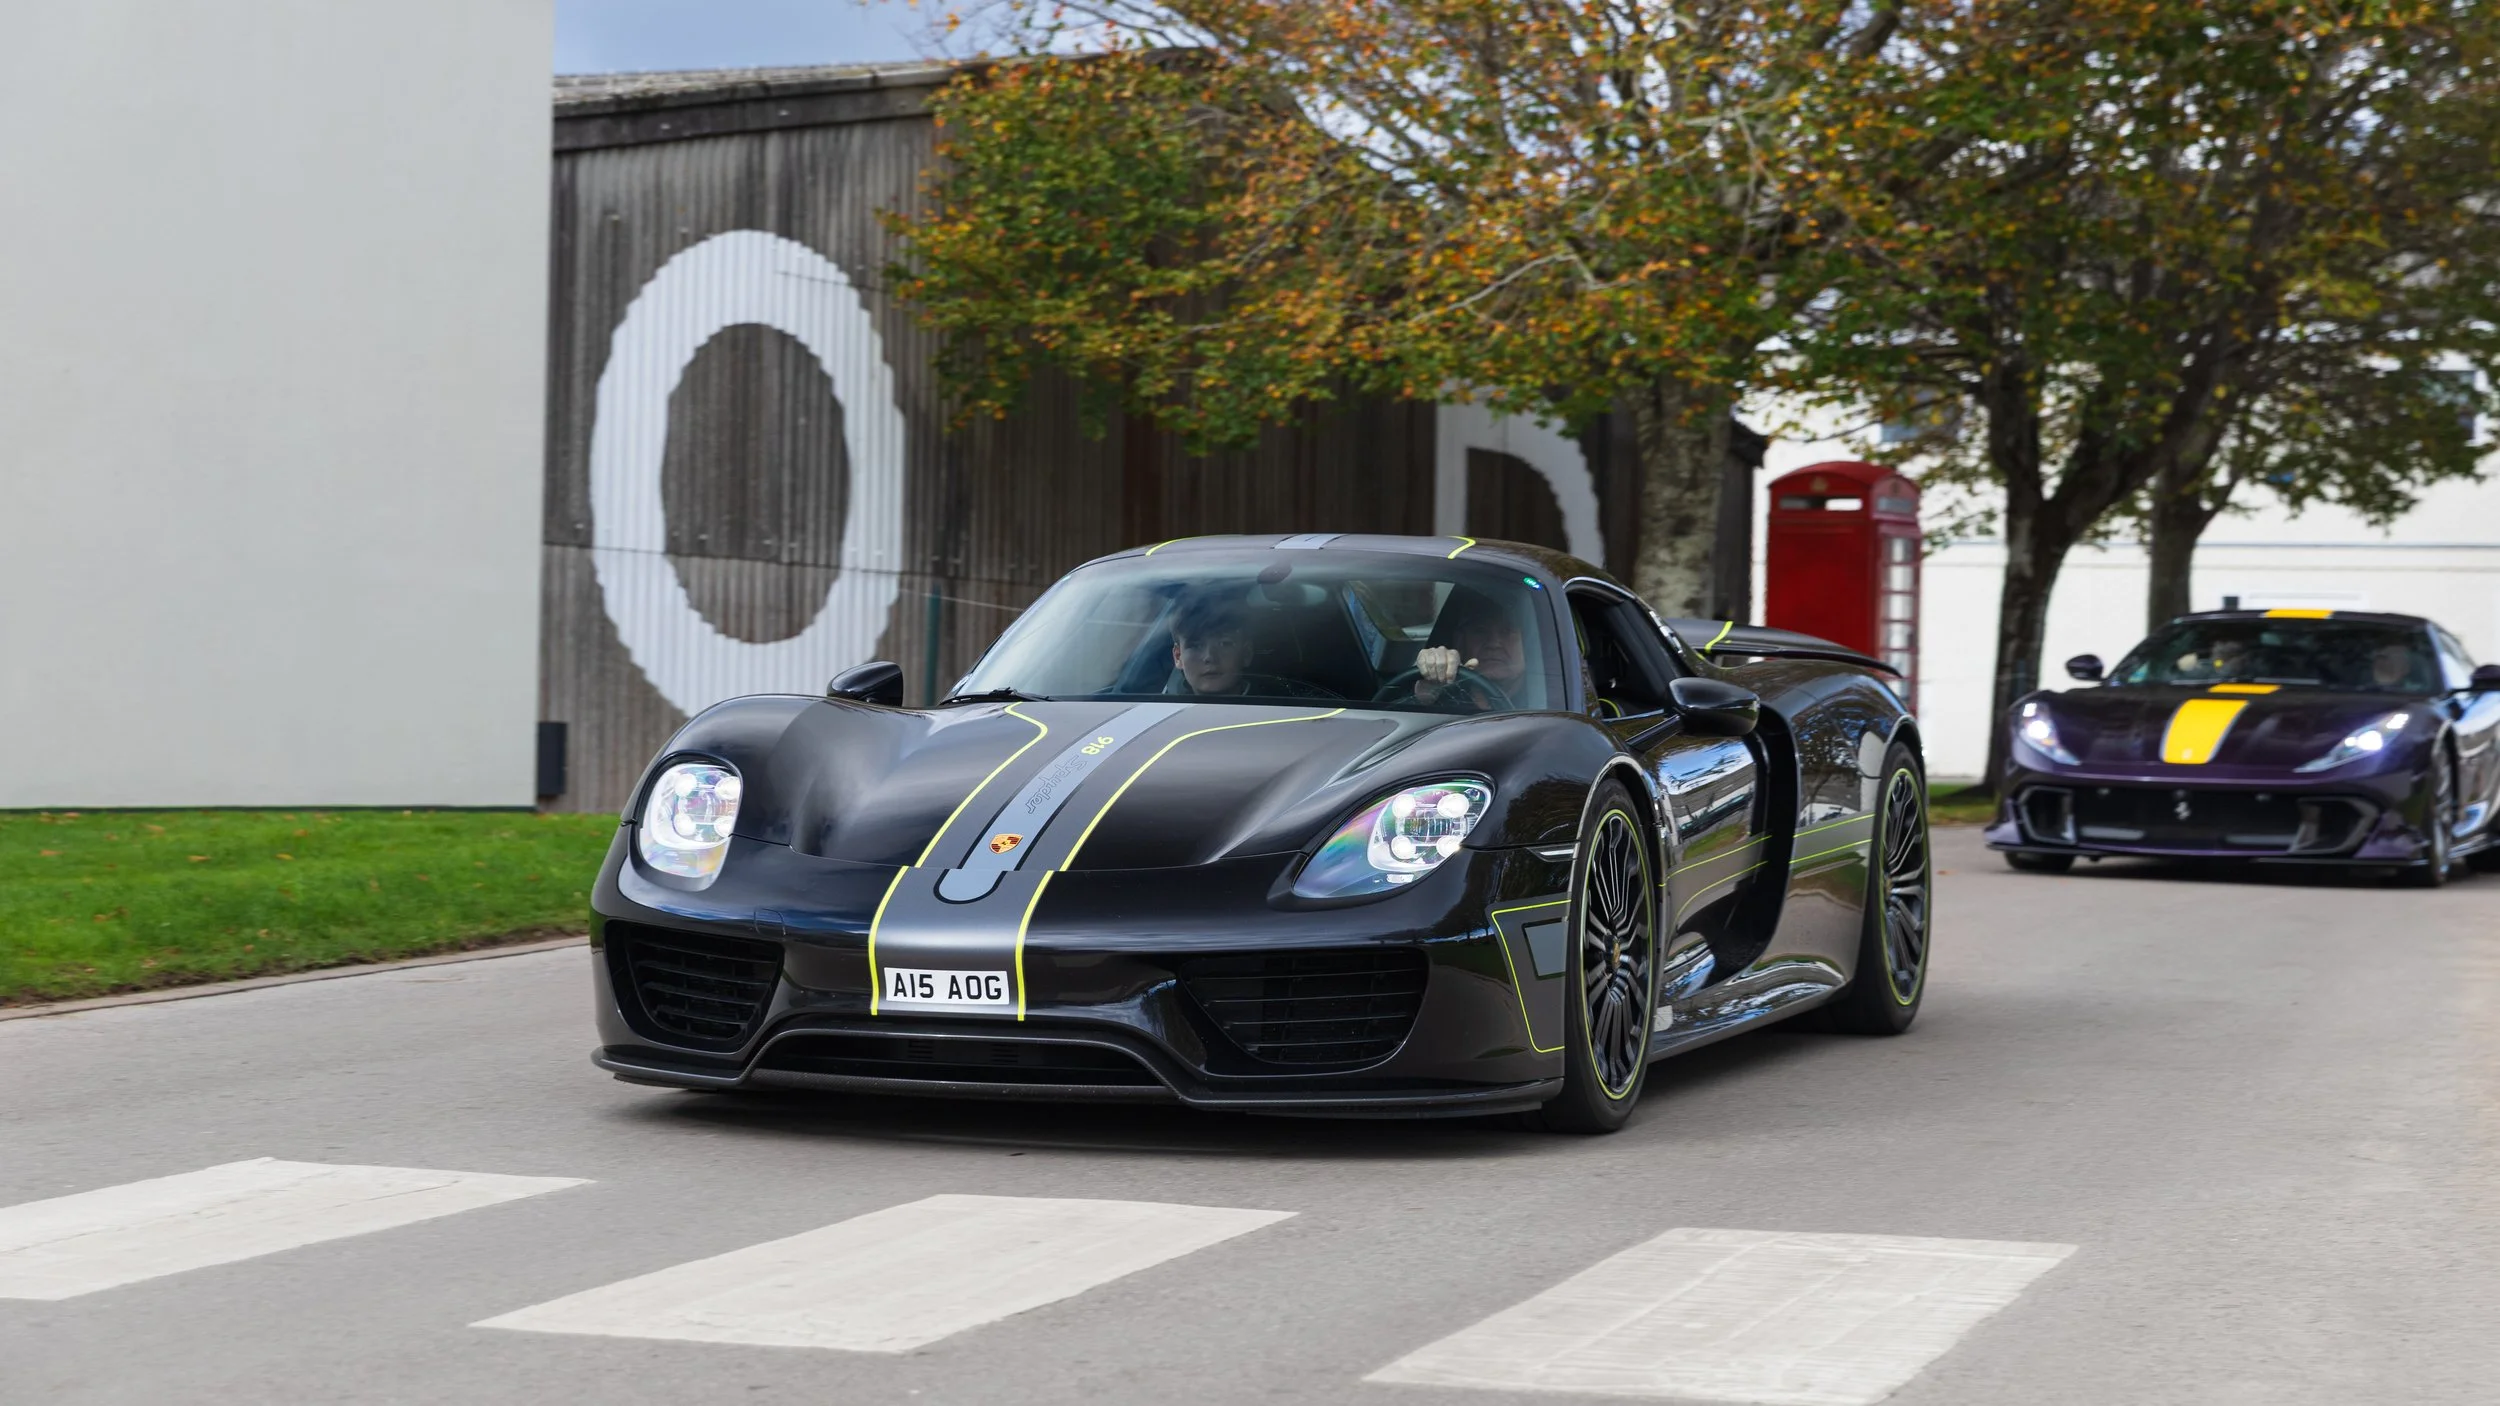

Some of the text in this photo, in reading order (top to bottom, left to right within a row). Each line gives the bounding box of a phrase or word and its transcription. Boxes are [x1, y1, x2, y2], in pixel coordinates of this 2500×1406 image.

[1024, 736, 1114, 815] 918 Spyder
[893, 972, 1002, 1000] A15 AOG
